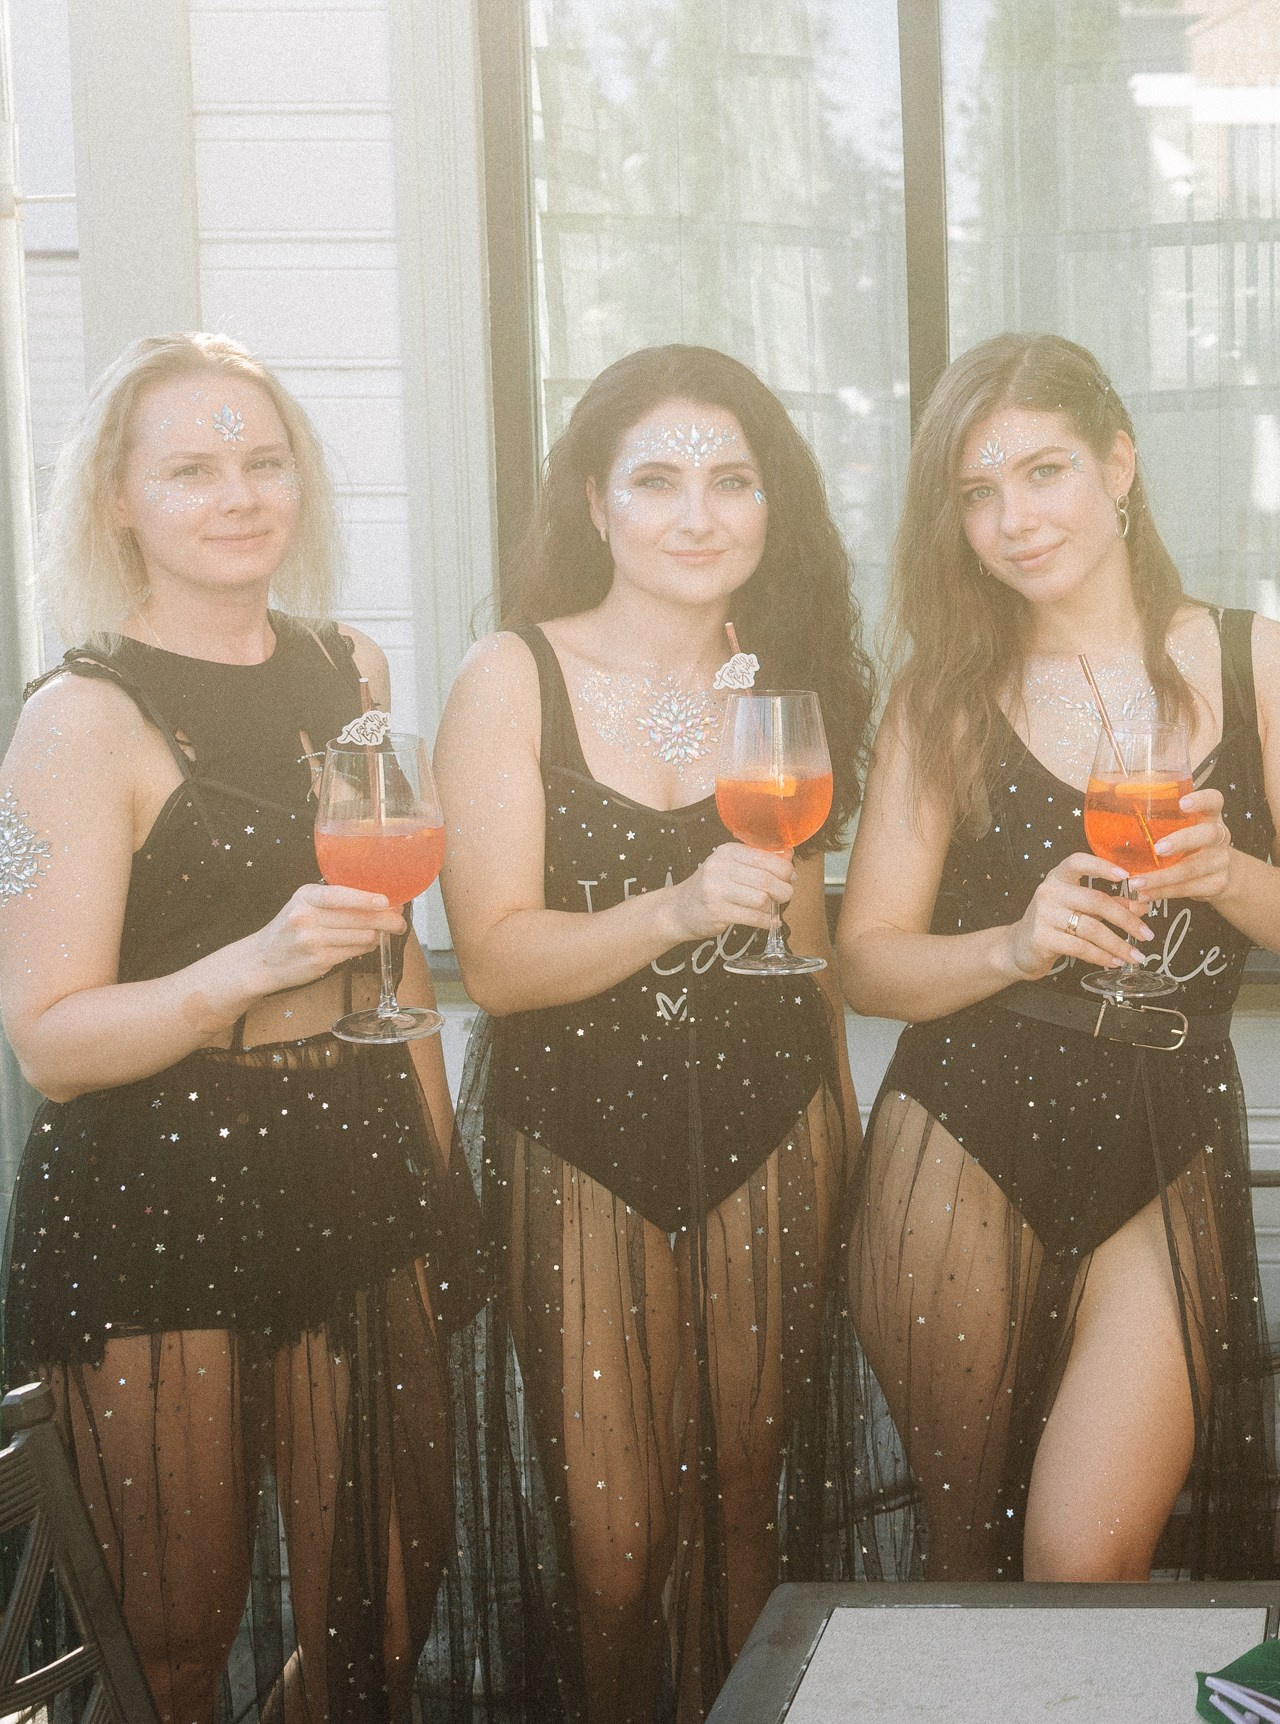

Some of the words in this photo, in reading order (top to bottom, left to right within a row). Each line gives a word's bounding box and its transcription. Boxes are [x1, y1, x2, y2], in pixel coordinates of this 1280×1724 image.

[716, 656, 743, 687] Team
[342, 716, 375, 743] Team
[361, 714, 388, 743] Bride
